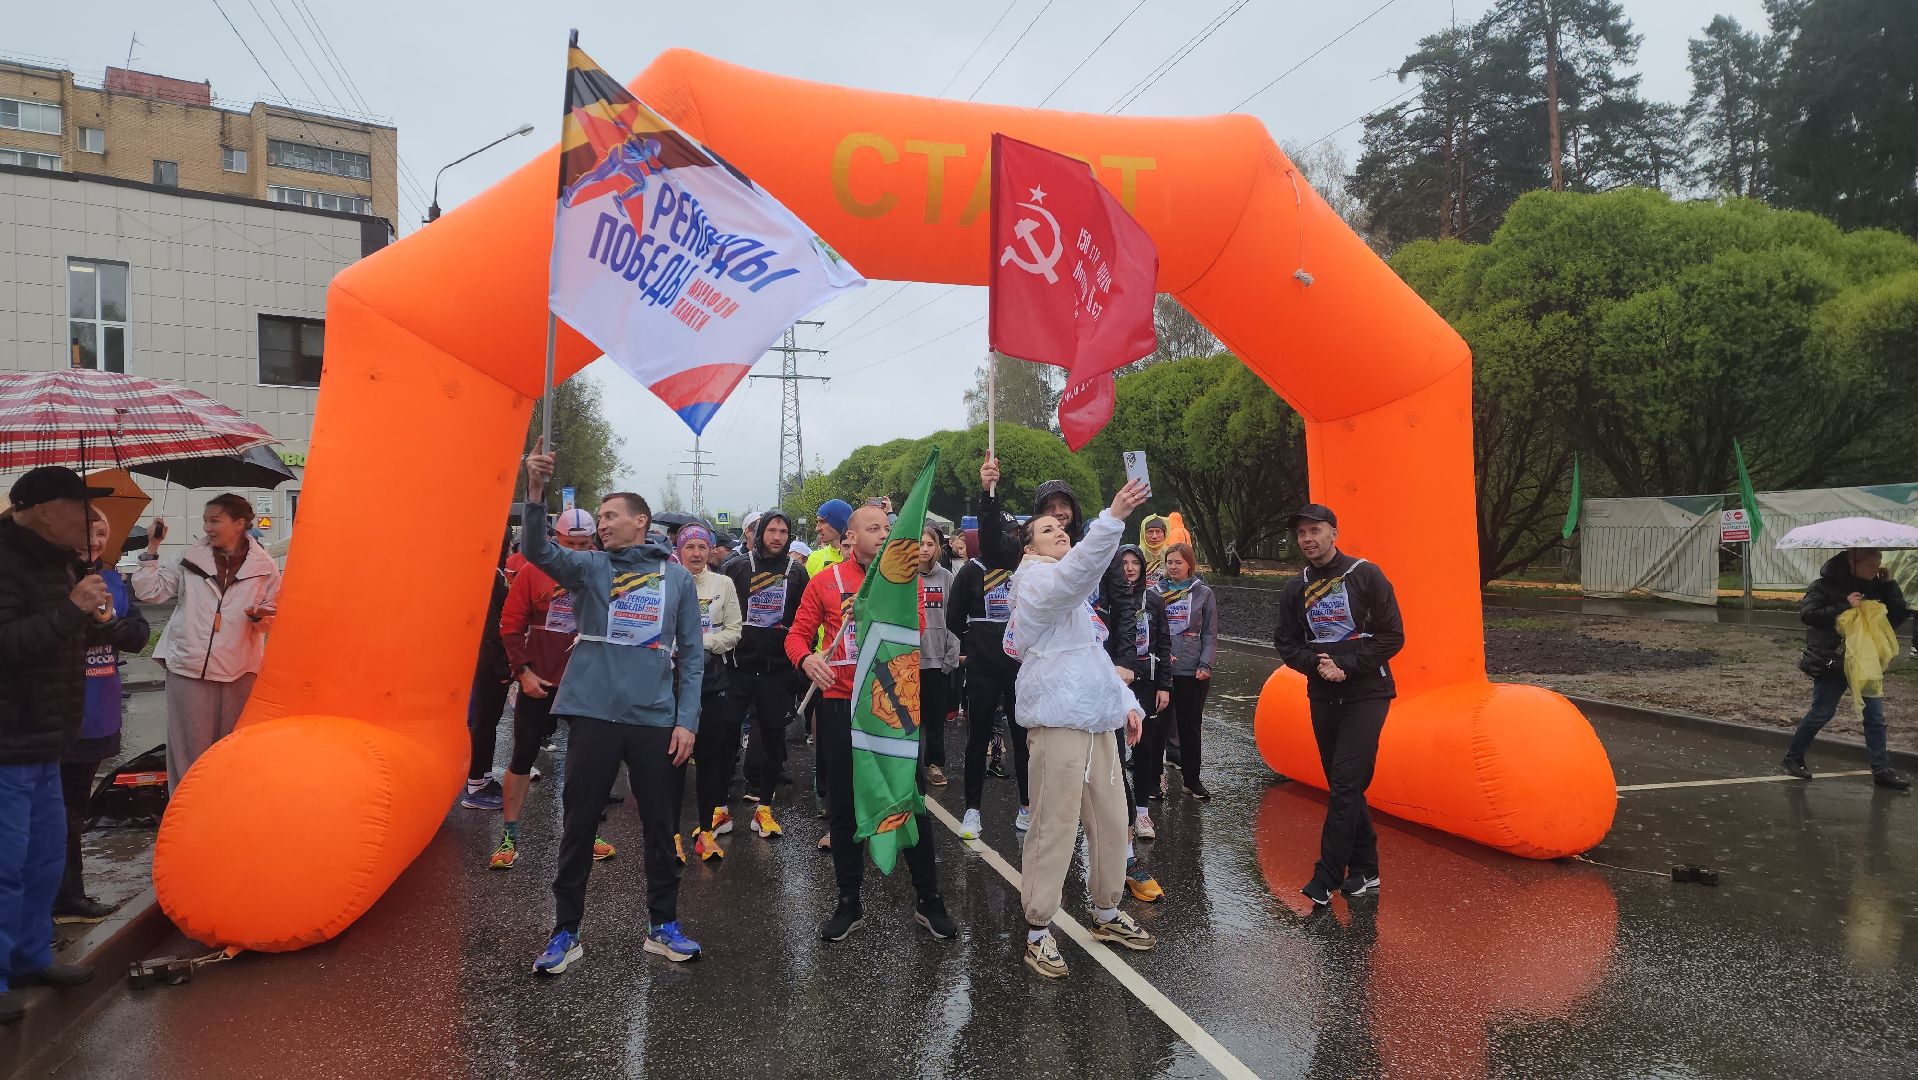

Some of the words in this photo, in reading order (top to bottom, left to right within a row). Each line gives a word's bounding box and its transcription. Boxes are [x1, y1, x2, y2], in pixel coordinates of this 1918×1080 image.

[831, 132, 1157, 228] СТТ
[650, 182, 800, 294] РЕКОРДЫ
[588, 211, 699, 309] ПОБЕДЫ
[671, 297, 711, 332] ПАМЯТИ
[686, 278, 740, 319] МАРАФОН
[615, 600, 645, 612] ПОБЕДЫ
[627, 594, 661, 606] РЕКОРДЫ
